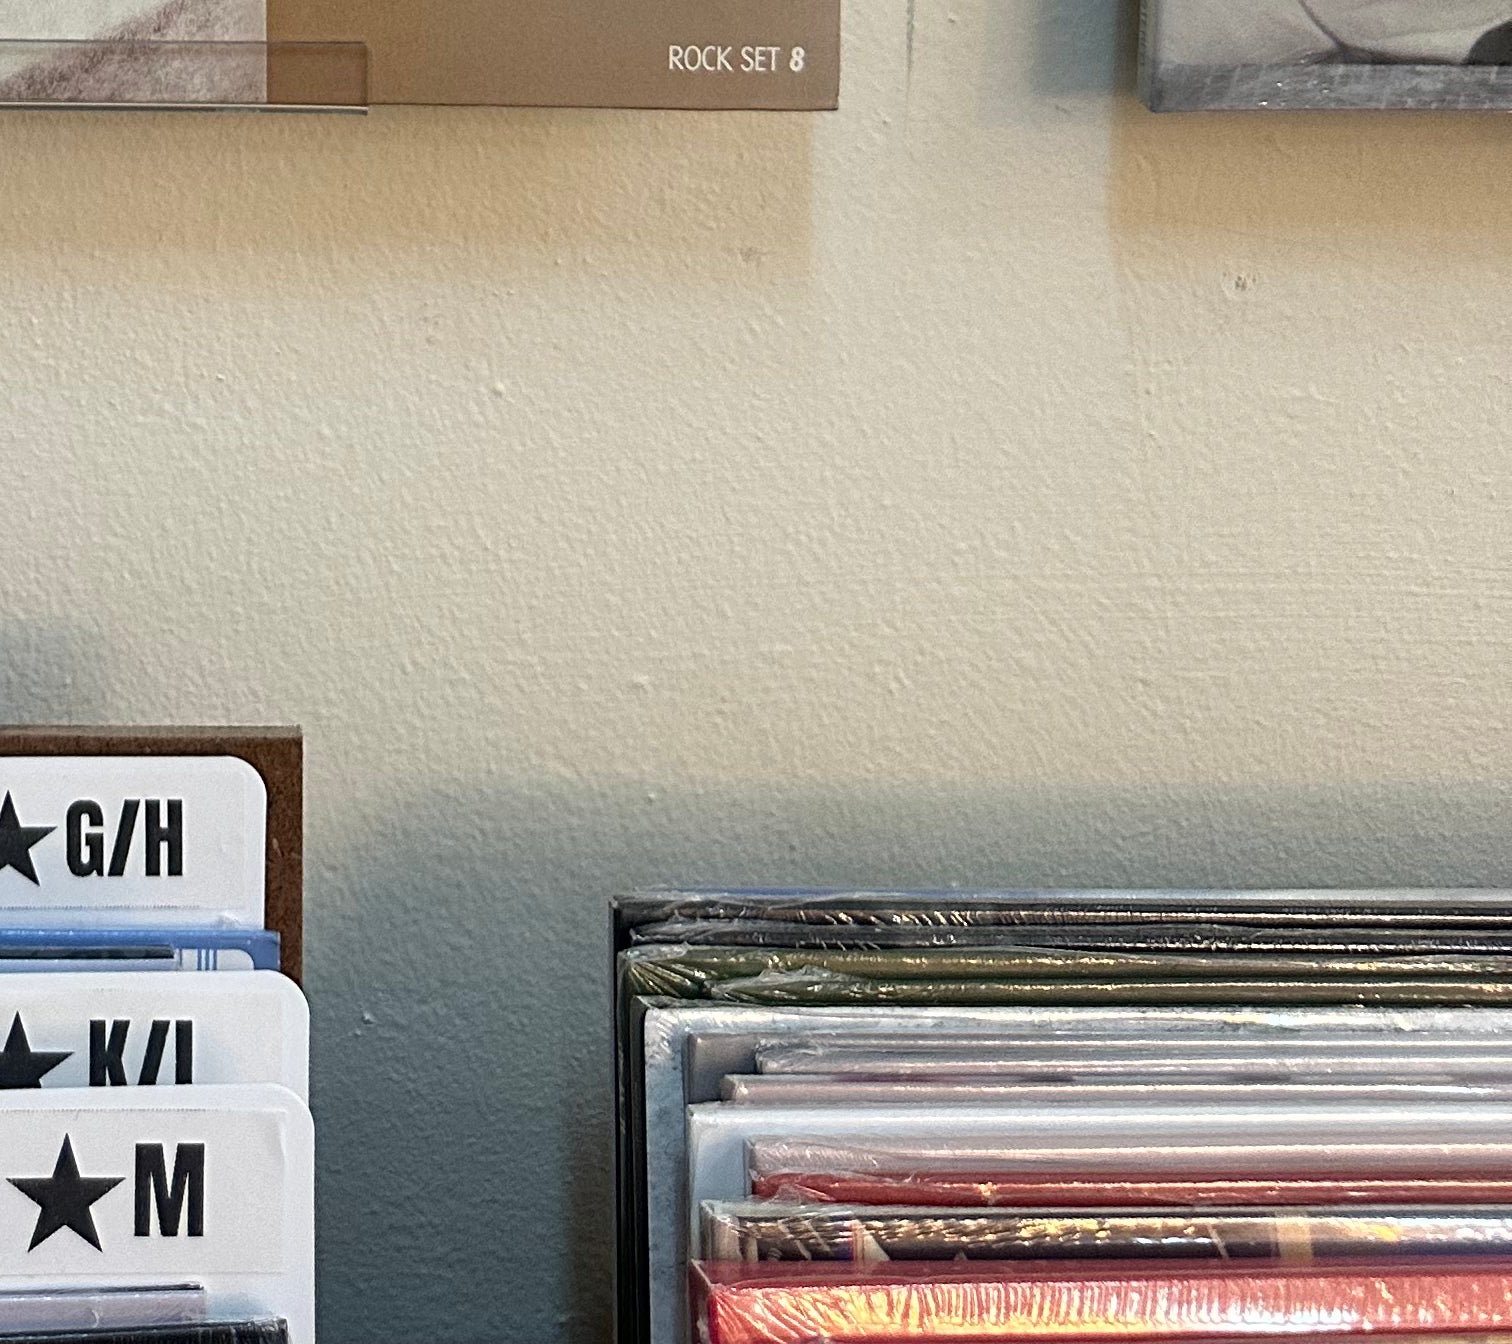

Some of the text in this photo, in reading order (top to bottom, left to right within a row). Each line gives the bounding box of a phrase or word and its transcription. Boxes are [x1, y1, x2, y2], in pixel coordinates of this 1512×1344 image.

[668, 44, 806, 72] ROCK SET 8
[65, 797, 184, 879] G/H
[133, 1142, 205, 1238] M
